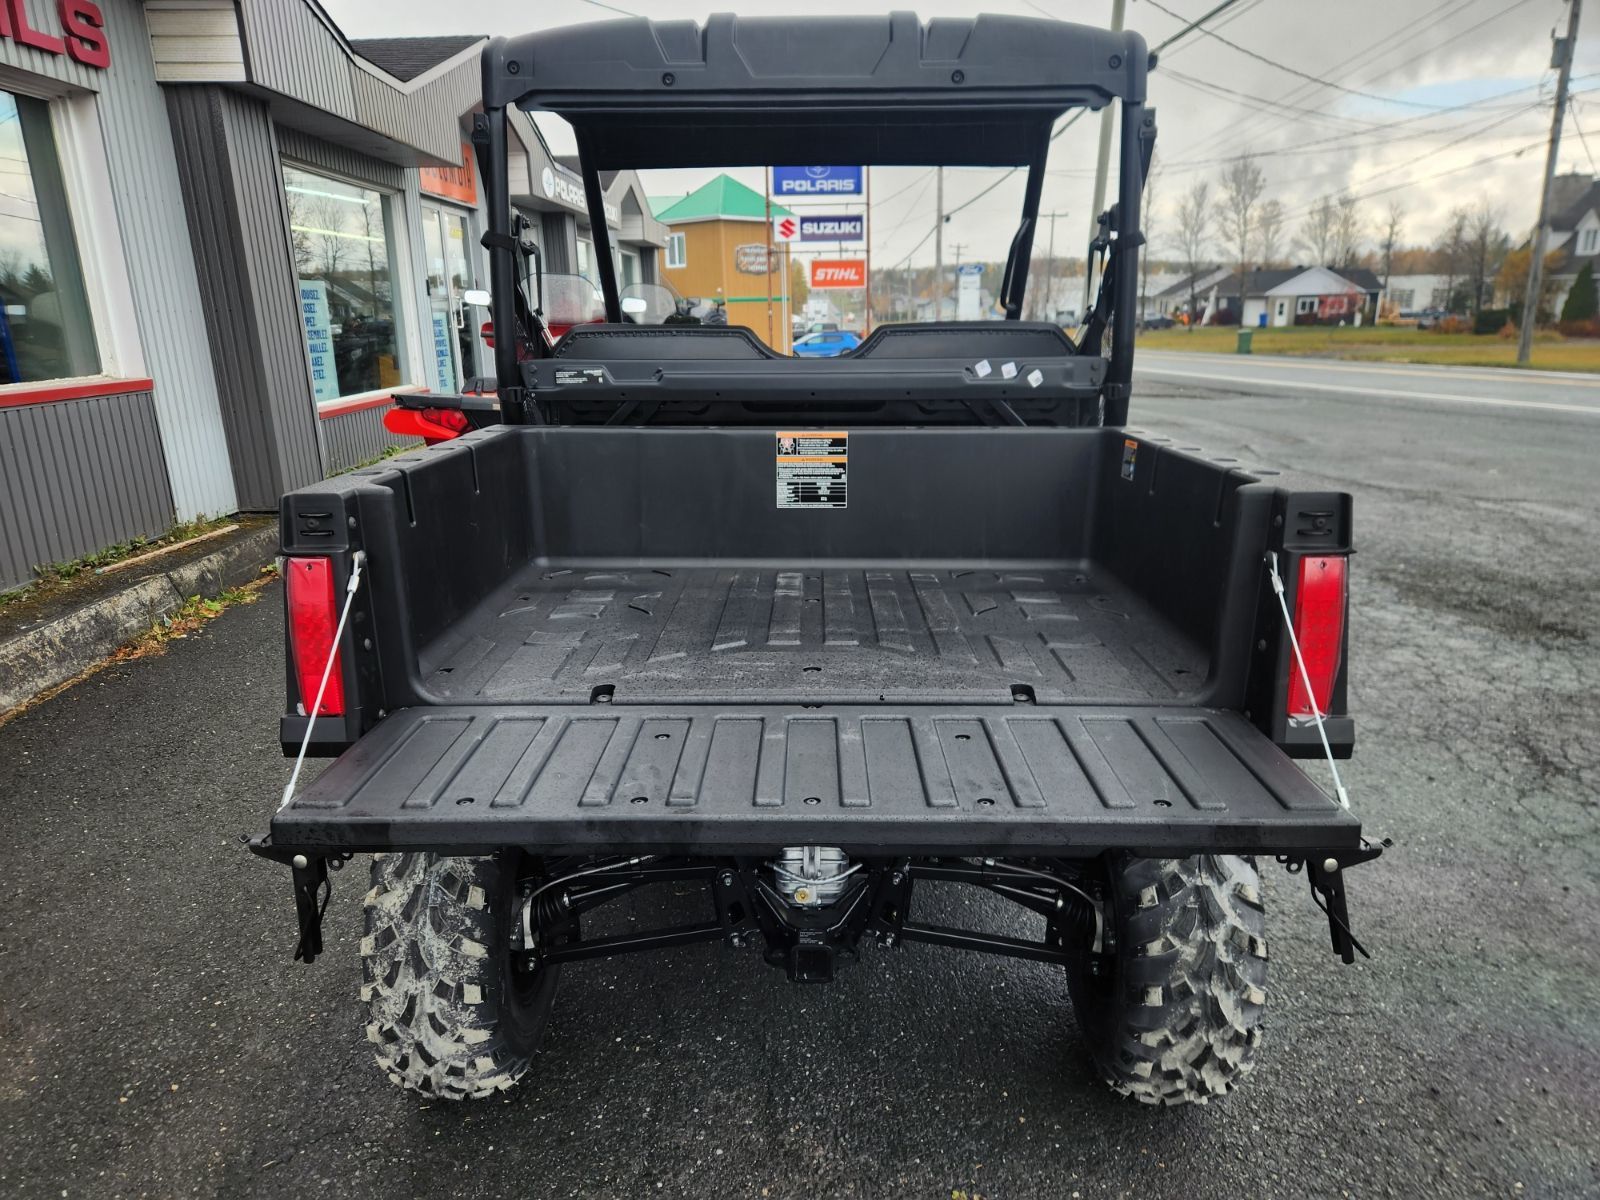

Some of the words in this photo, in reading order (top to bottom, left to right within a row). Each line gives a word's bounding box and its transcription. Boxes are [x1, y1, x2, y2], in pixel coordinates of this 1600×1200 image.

[782, 179, 855, 192] POLARIS
[802, 222, 861, 234] SUZUKI
[815, 268, 860, 281] STIHL
